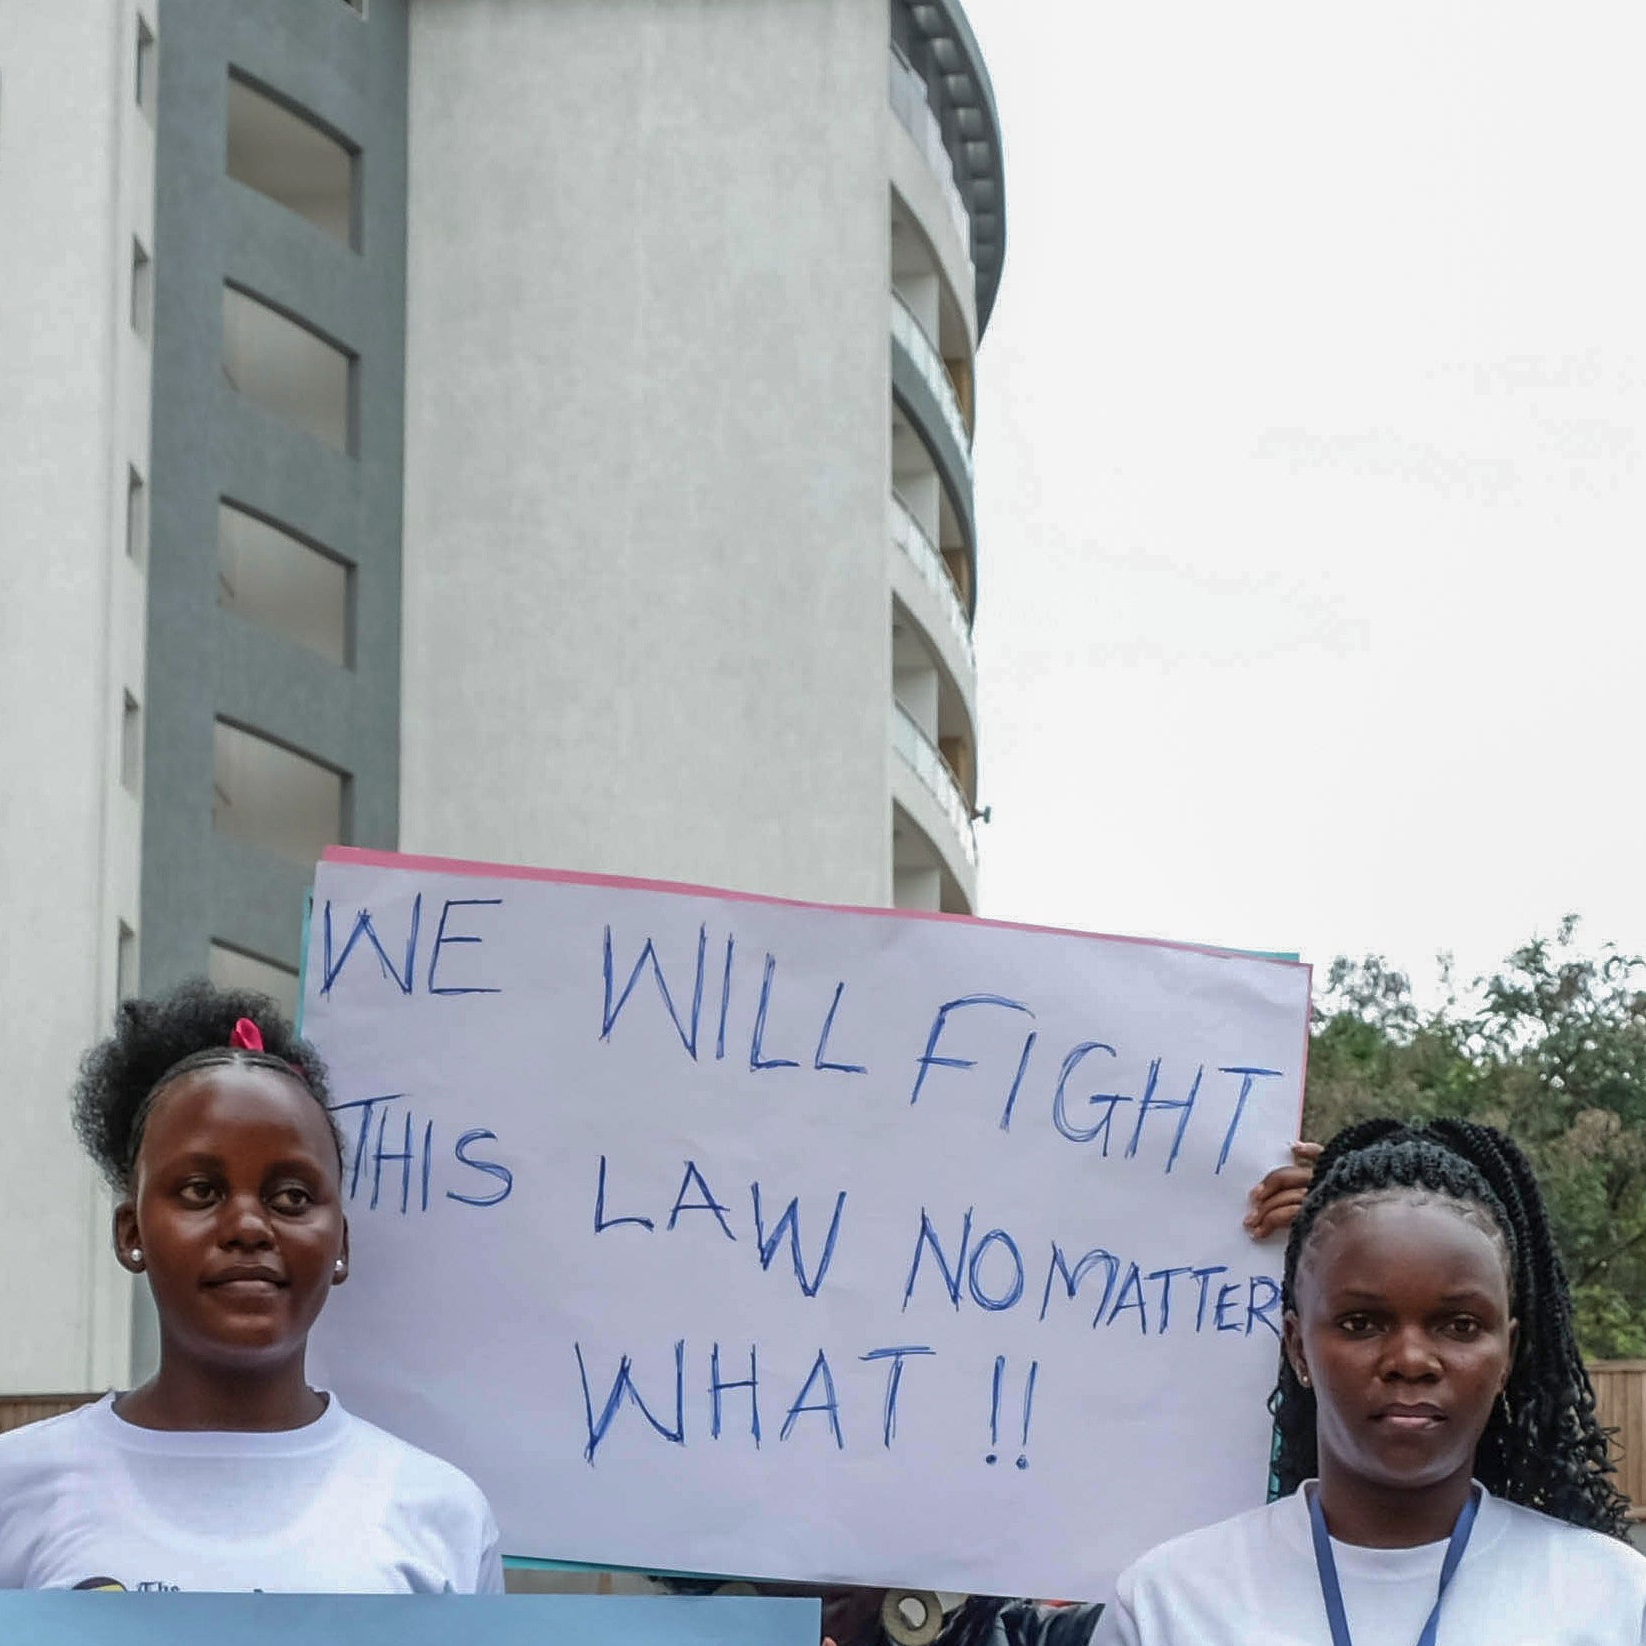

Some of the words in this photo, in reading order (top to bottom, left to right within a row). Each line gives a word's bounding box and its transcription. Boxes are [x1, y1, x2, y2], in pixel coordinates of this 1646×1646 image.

[322, 893, 503, 996] WE
[599, 923, 867, 1074] WILL
[910, 994, 1282, 1174] FIGHT
[327, 1093, 513, 1213] THIS
[594, 1155, 847, 1298] LAW
[902, 1206, 1024, 1313] NO
[1039, 1240, 1282, 1338] MATTER
[575, 1339, 936, 1467] WHAT
